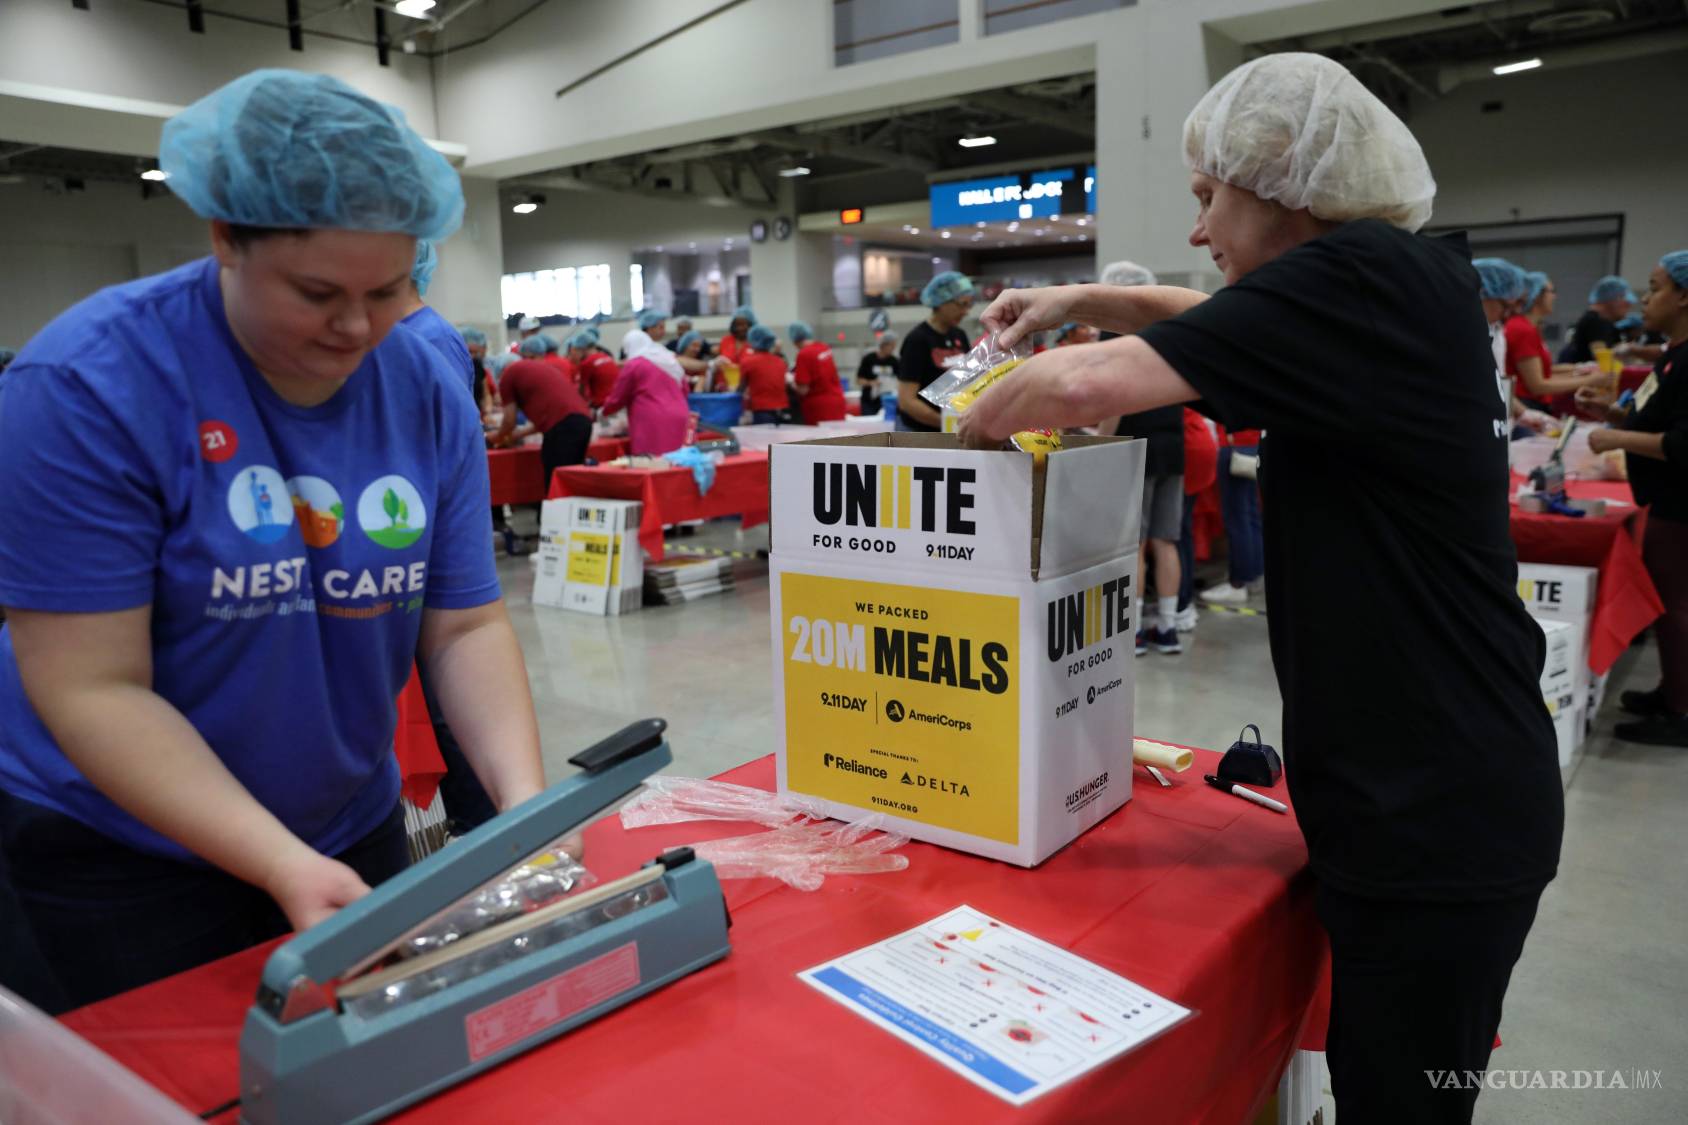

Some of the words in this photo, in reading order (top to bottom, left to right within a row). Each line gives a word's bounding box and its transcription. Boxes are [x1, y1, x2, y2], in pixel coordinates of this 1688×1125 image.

[203, 430, 226, 449] 21
[813, 534, 842, 549] FOR
[849, 537, 896, 553] GOOD
[211, 557, 306, 599] NEST
[323, 562, 426, 599] CARE
[855, 602, 874, 614] WE
[878, 605, 929, 620] PACKED
[789, 615, 866, 673] 20M
[873, 626, 1009, 694] MEALS
[1067, 660, 1085, 678] FOR
[1088, 648, 1112, 668] GOOD
[1097, 678, 1122, 696] AmeriCorps
[908, 709, 972, 731] AmeriCorps
[835, 756, 888, 779] Reliance
[917, 775, 970, 797] DELTA
[871, 796, 918, 813] 911DAY.ORG
